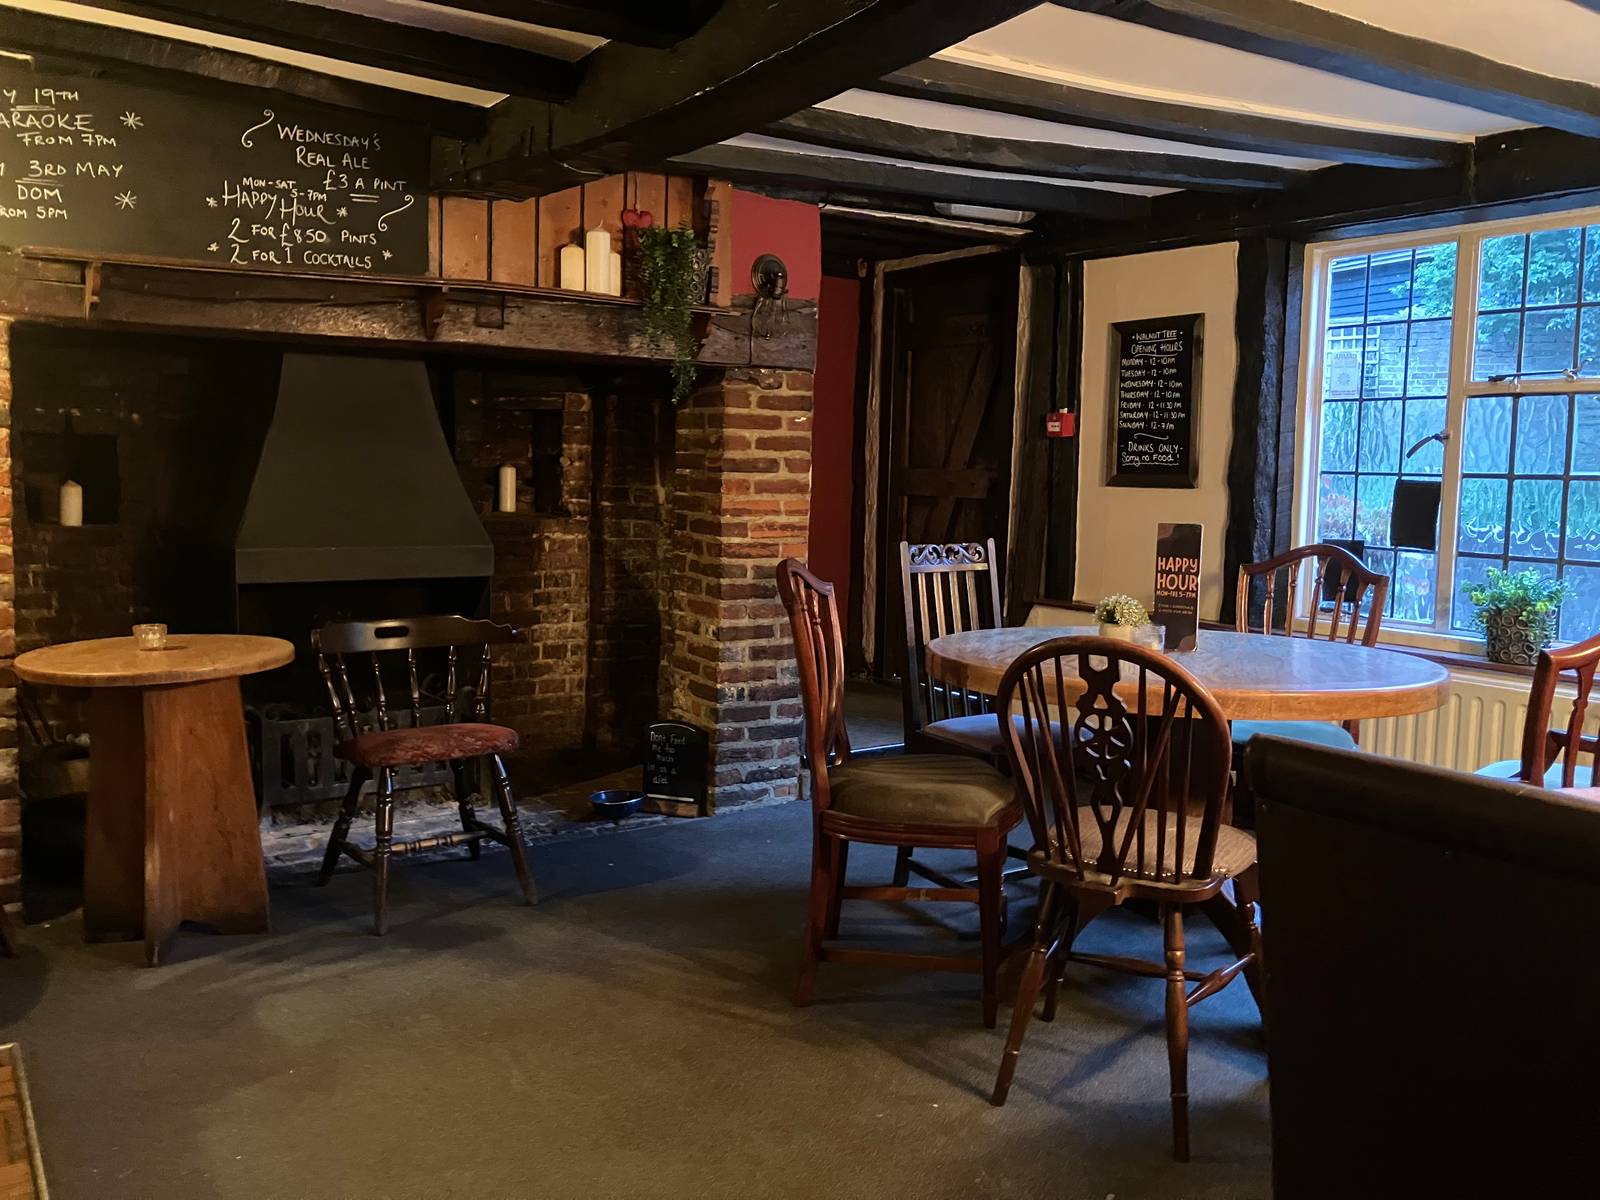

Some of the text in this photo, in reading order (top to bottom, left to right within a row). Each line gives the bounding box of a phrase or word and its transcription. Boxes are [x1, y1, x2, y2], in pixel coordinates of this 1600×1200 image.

[35, 88, 79, 104] 19TH
[16, 131, 117, 147] FROM 7PM
[277, 123, 381, 151] WEDNESDAY'S
[296, 145, 371, 170] REAL ALE
[27, 160, 123, 178] 3RD MAY
[323, 169, 407, 191] £3 A PINT
[17, 184, 62, 203] DOM
[222, 180, 337, 226] HAPPY HOUR
[0, 205, 68, 220] ROM 5PM
[228, 218, 250, 243] 2
[251, 224, 277, 240] FOR
[341, 229, 377, 245] PINTS
[230, 243, 372, 269] 2 FOR 1 COCKTAILS
[1162, 330, 1178, 338] TREE
[1131, 341, 1183, 354] OPENING HOURS
[1128, 441, 1179, 454] DRINKS ONLY
[1158, 556, 1198, 573] HAPPY
[1156, 572, 1198, 591] HOUR
